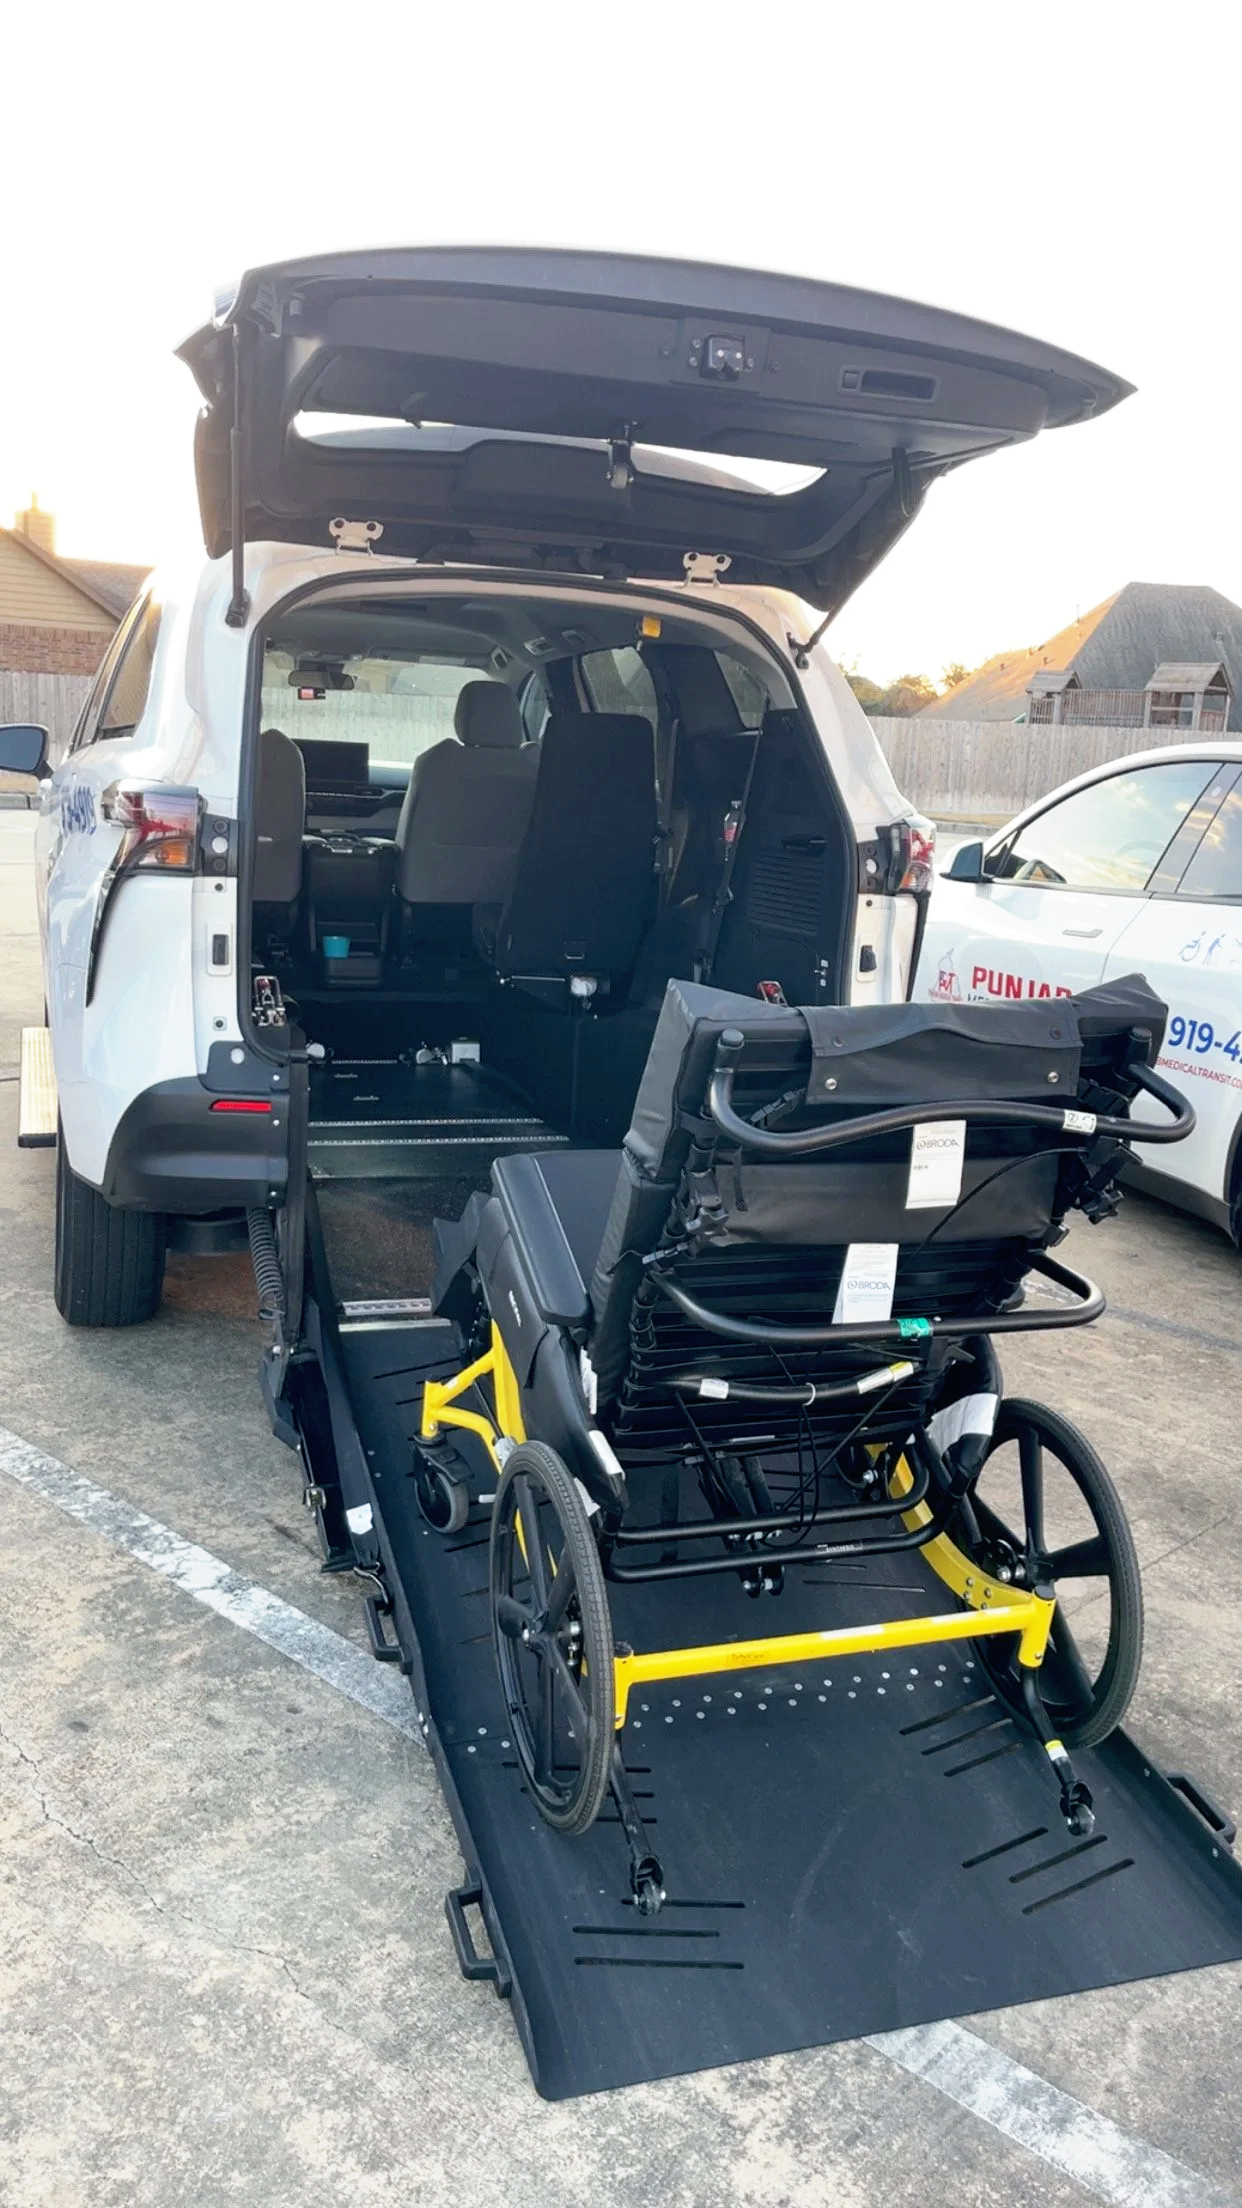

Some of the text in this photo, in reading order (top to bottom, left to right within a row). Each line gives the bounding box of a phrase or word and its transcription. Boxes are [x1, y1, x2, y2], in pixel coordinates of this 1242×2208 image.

[1168, 1016, 1242, 1065] 919-4
[926, 1138, 960, 1148] BRODA
[858, 1281, 891, 1290] BRODA
